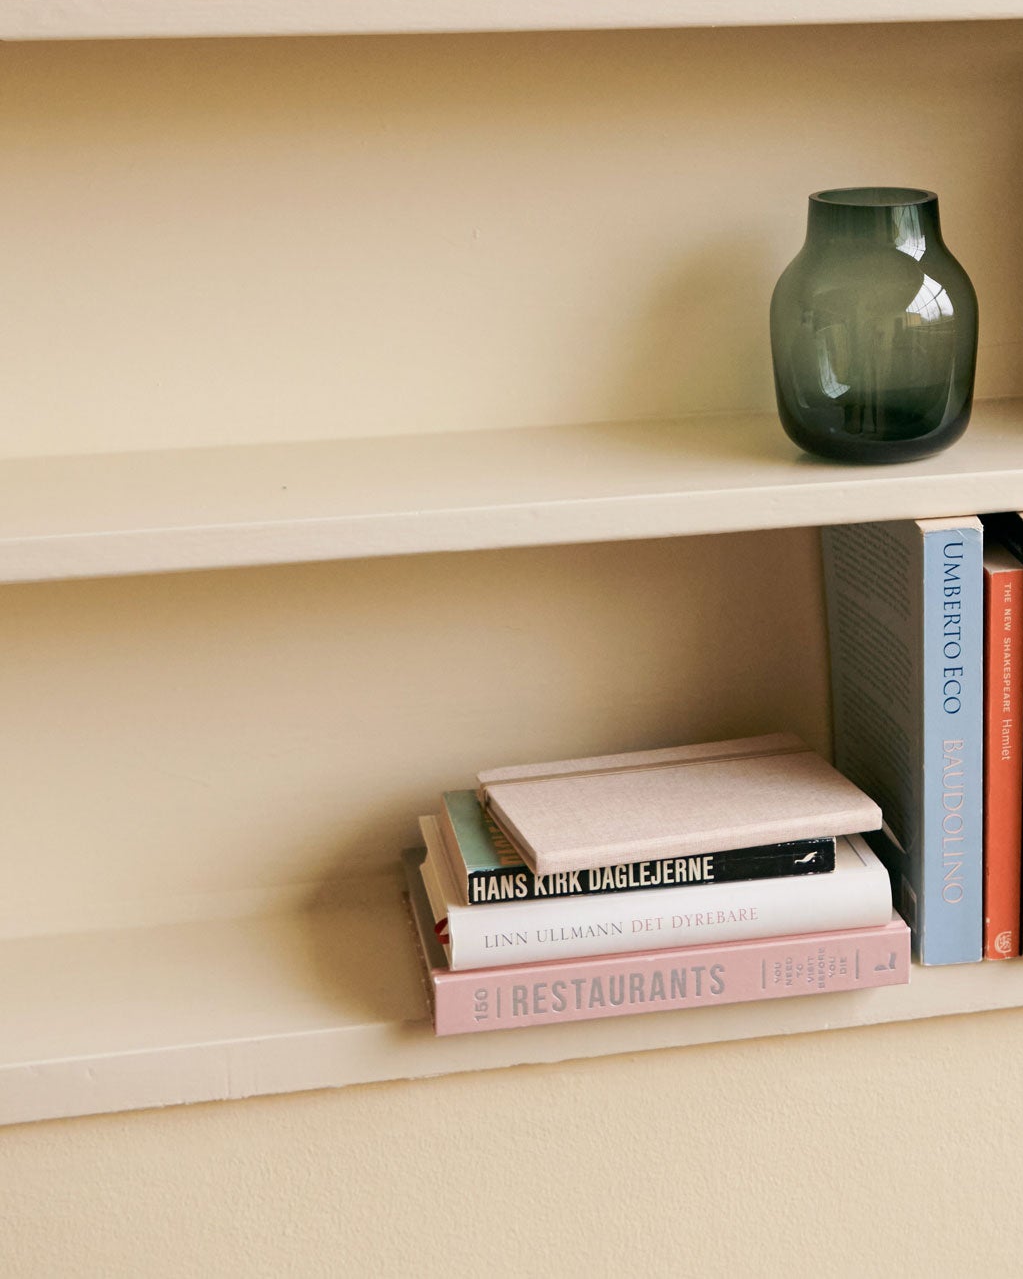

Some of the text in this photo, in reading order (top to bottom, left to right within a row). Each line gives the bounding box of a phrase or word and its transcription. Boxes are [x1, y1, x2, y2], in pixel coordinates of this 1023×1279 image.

[1000, 582, 1013, 761] THE NEW SHAKESPEARE Hamlet
[941, 541, 965, 905] UMBERTO ECO BAUDOLINO
[473, 856, 715, 902] HANS KIRK DAGLEJERNE
[484, 906, 760, 950] LINN ULLMANN DET DYREBARE
[774, 961, 782, 984] YOU
[785, 956, 793, 986] NEED
[807, 955, 815, 983] VISIT
[817, 946, 826, 989] BEFORE
[828, 956, 836, 978] YOU
[839, 955, 847, 975] DIE
[474, 987, 489, 1023] 150
[511, 963, 727, 1018] RESTAURANTS
